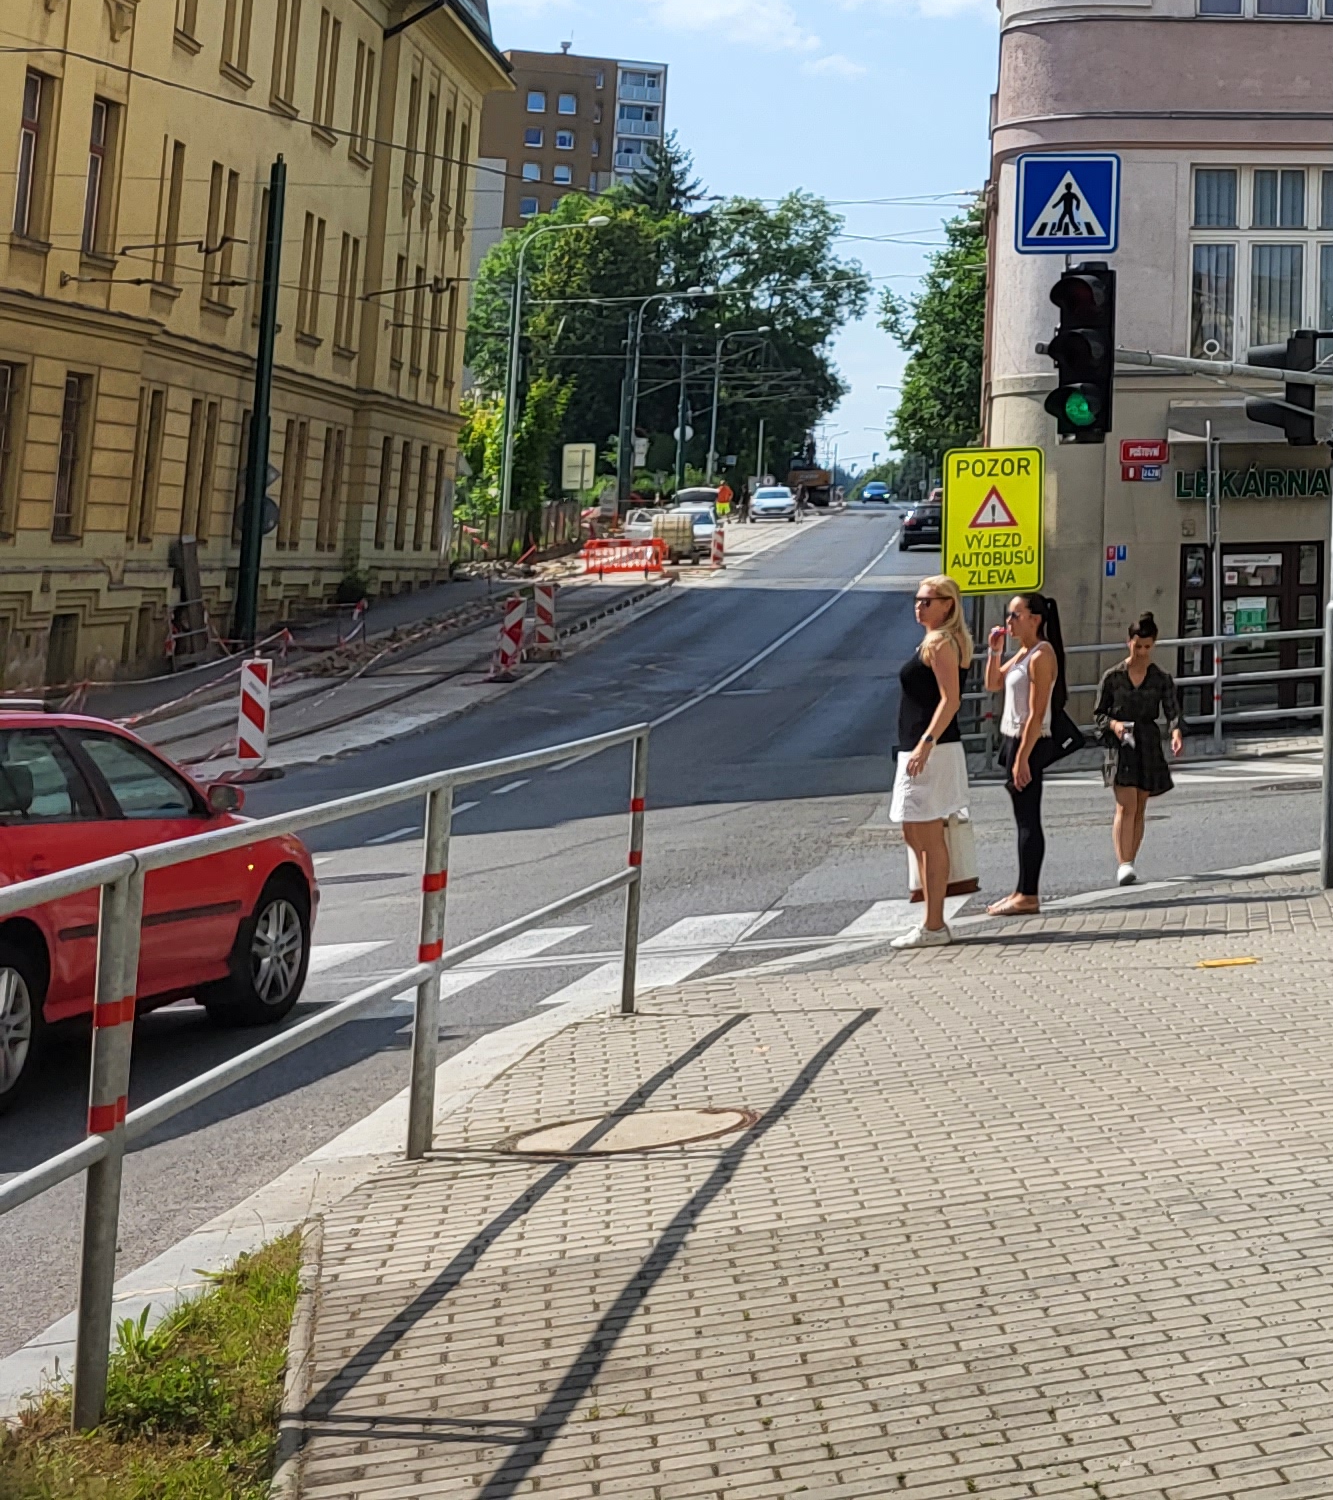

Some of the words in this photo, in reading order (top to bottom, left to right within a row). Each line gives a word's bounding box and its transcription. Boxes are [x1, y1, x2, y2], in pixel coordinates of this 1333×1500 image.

[956, 457, 1031, 478] POZOR
[965, 531, 1022, 550] VÝJEZD
[951, 546, 1035, 569] AUTOBUSŮ
[968, 569, 1016, 586] ZLEVA
